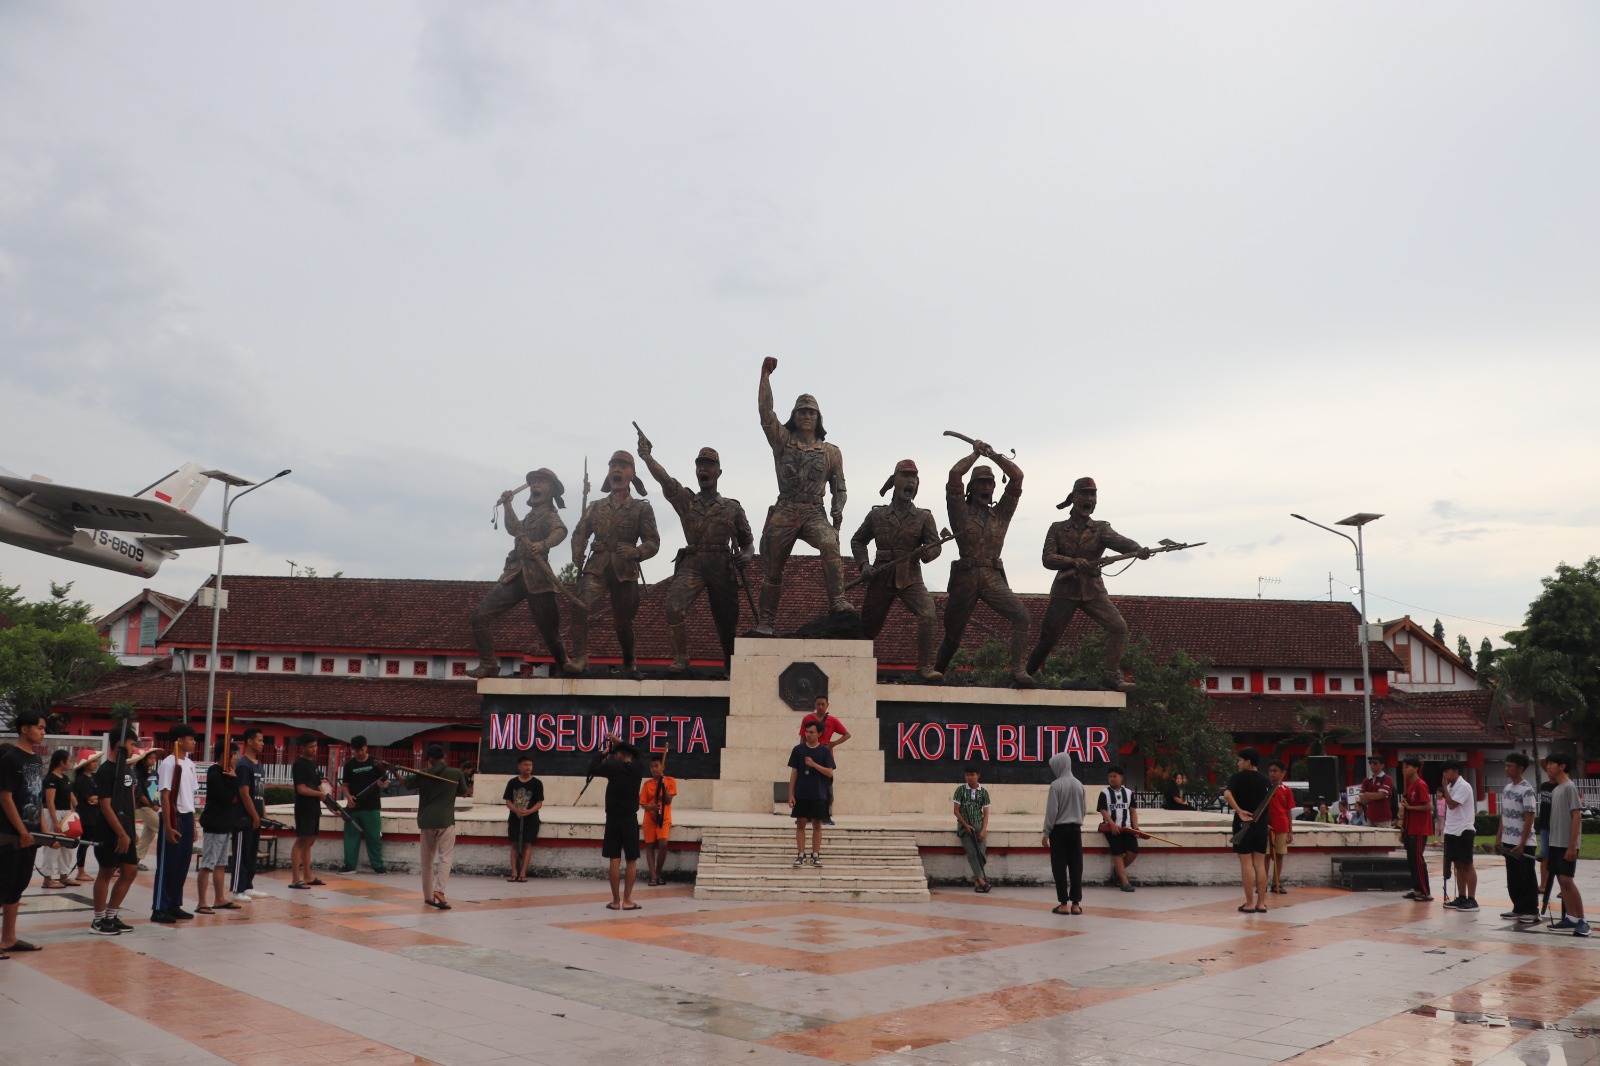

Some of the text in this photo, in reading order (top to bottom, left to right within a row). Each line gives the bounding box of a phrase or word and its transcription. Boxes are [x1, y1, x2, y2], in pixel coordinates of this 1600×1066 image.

[72, 502, 154, 522] AURI
[93, 529, 144, 562] TS-8609
[490, 713, 710, 753] MUSEUM PETA
[897, 722, 1111, 763] KOTA BLITAR
